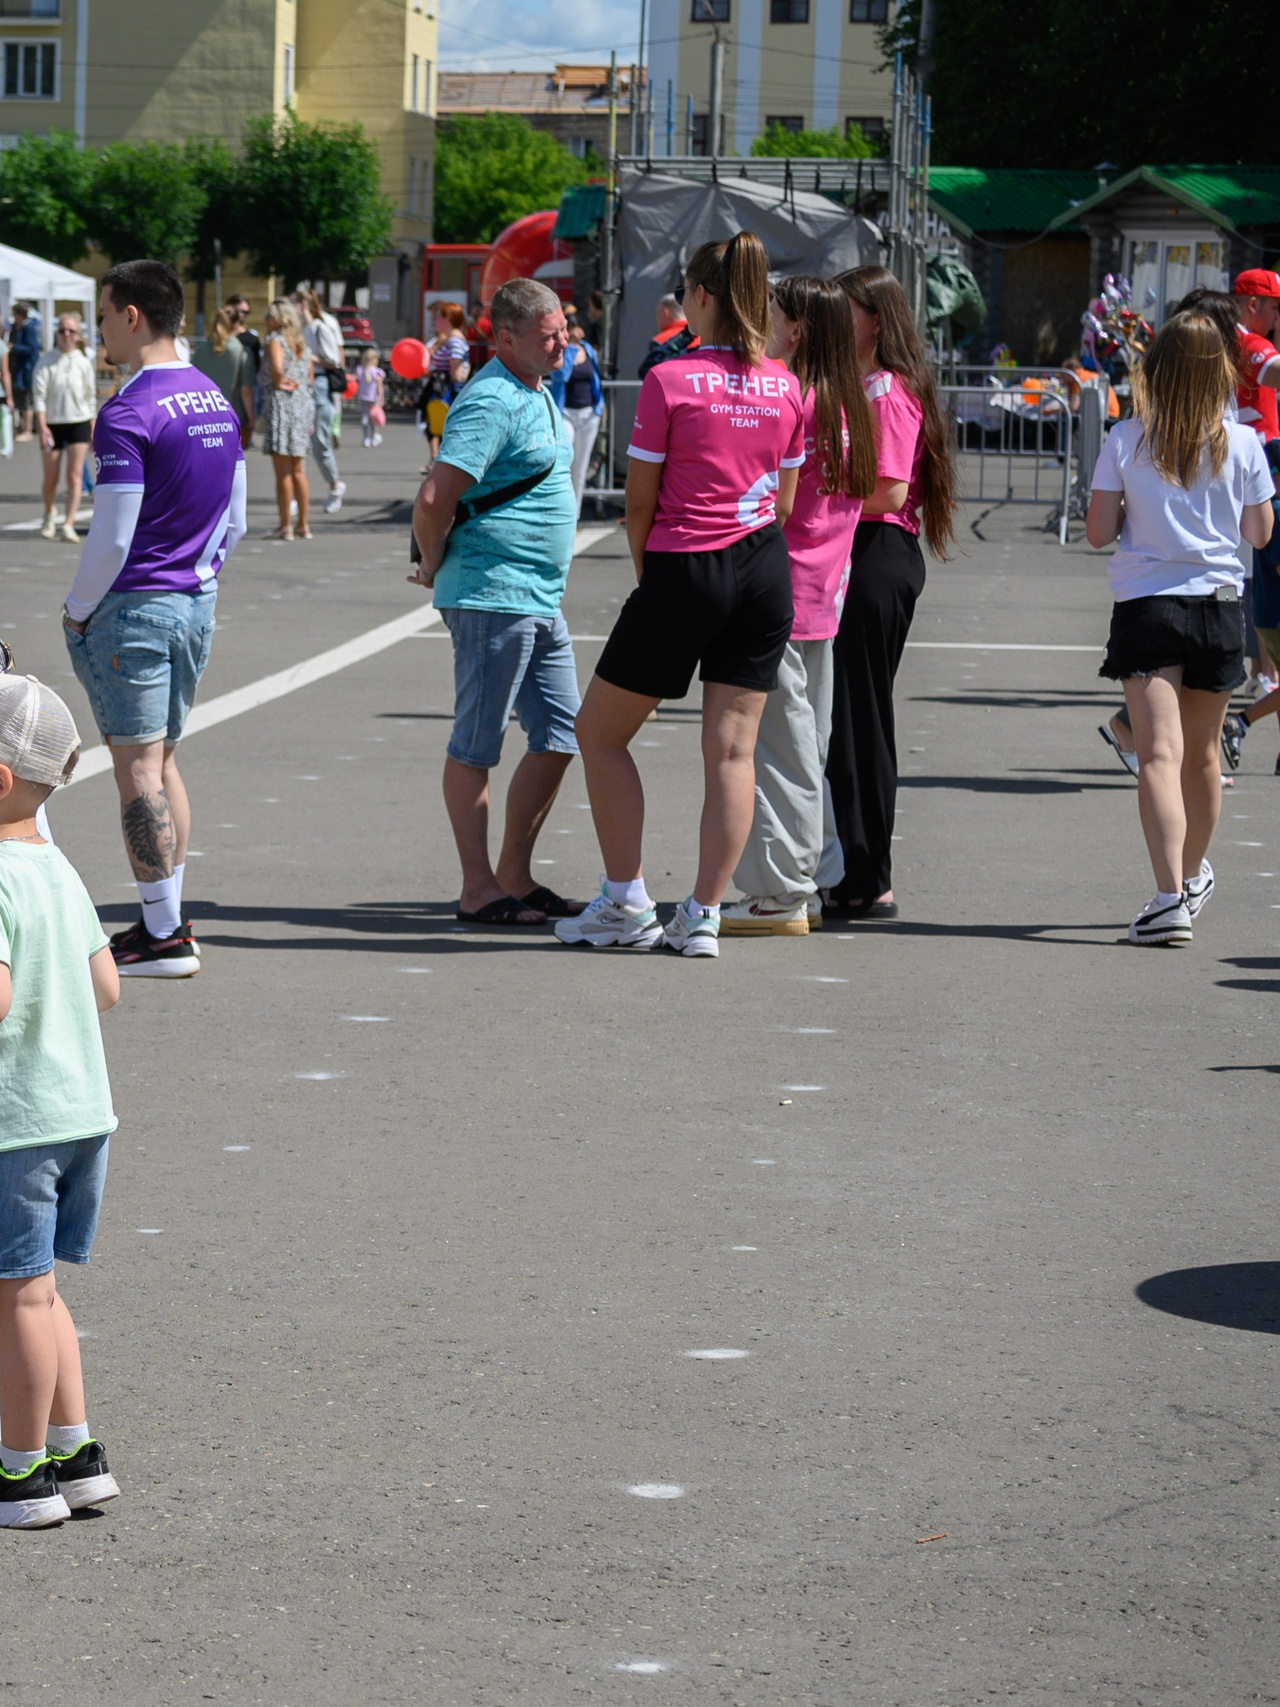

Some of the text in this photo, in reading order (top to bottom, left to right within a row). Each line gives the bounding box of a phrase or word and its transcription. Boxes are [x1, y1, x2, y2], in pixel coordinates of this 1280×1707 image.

[685, 372, 790, 398] ТРЕНЕР
[710, 403, 781, 417] GYM STATION
[187, 422, 234, 437] GYM STATION
[729, 417, 759, 429] TEAM
[201, 436, 224, 448] TEAM
[102, 459, 130, 467] STATION
